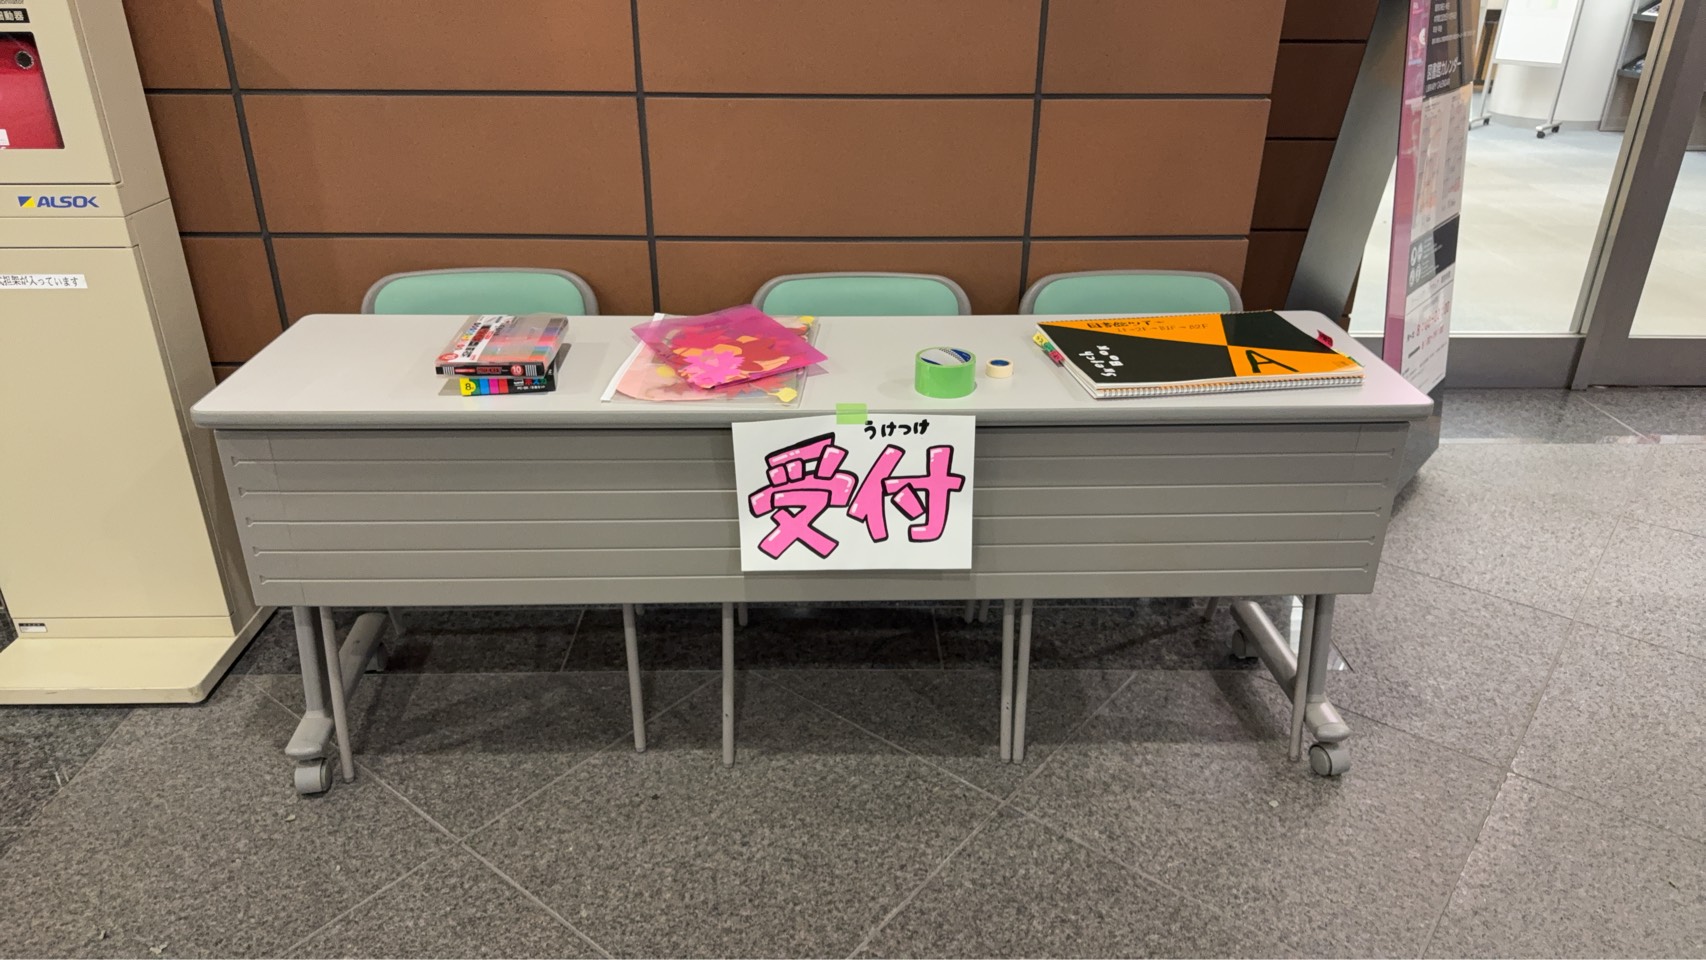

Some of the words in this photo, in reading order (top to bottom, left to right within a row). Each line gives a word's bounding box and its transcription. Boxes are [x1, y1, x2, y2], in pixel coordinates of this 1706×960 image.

[37, 196, 99, 208] ALSOK
[1245, 350, 1300, 373] A
[864, 419, 930, 440] うけつけ
[748, 432, 966, 560] 受付
